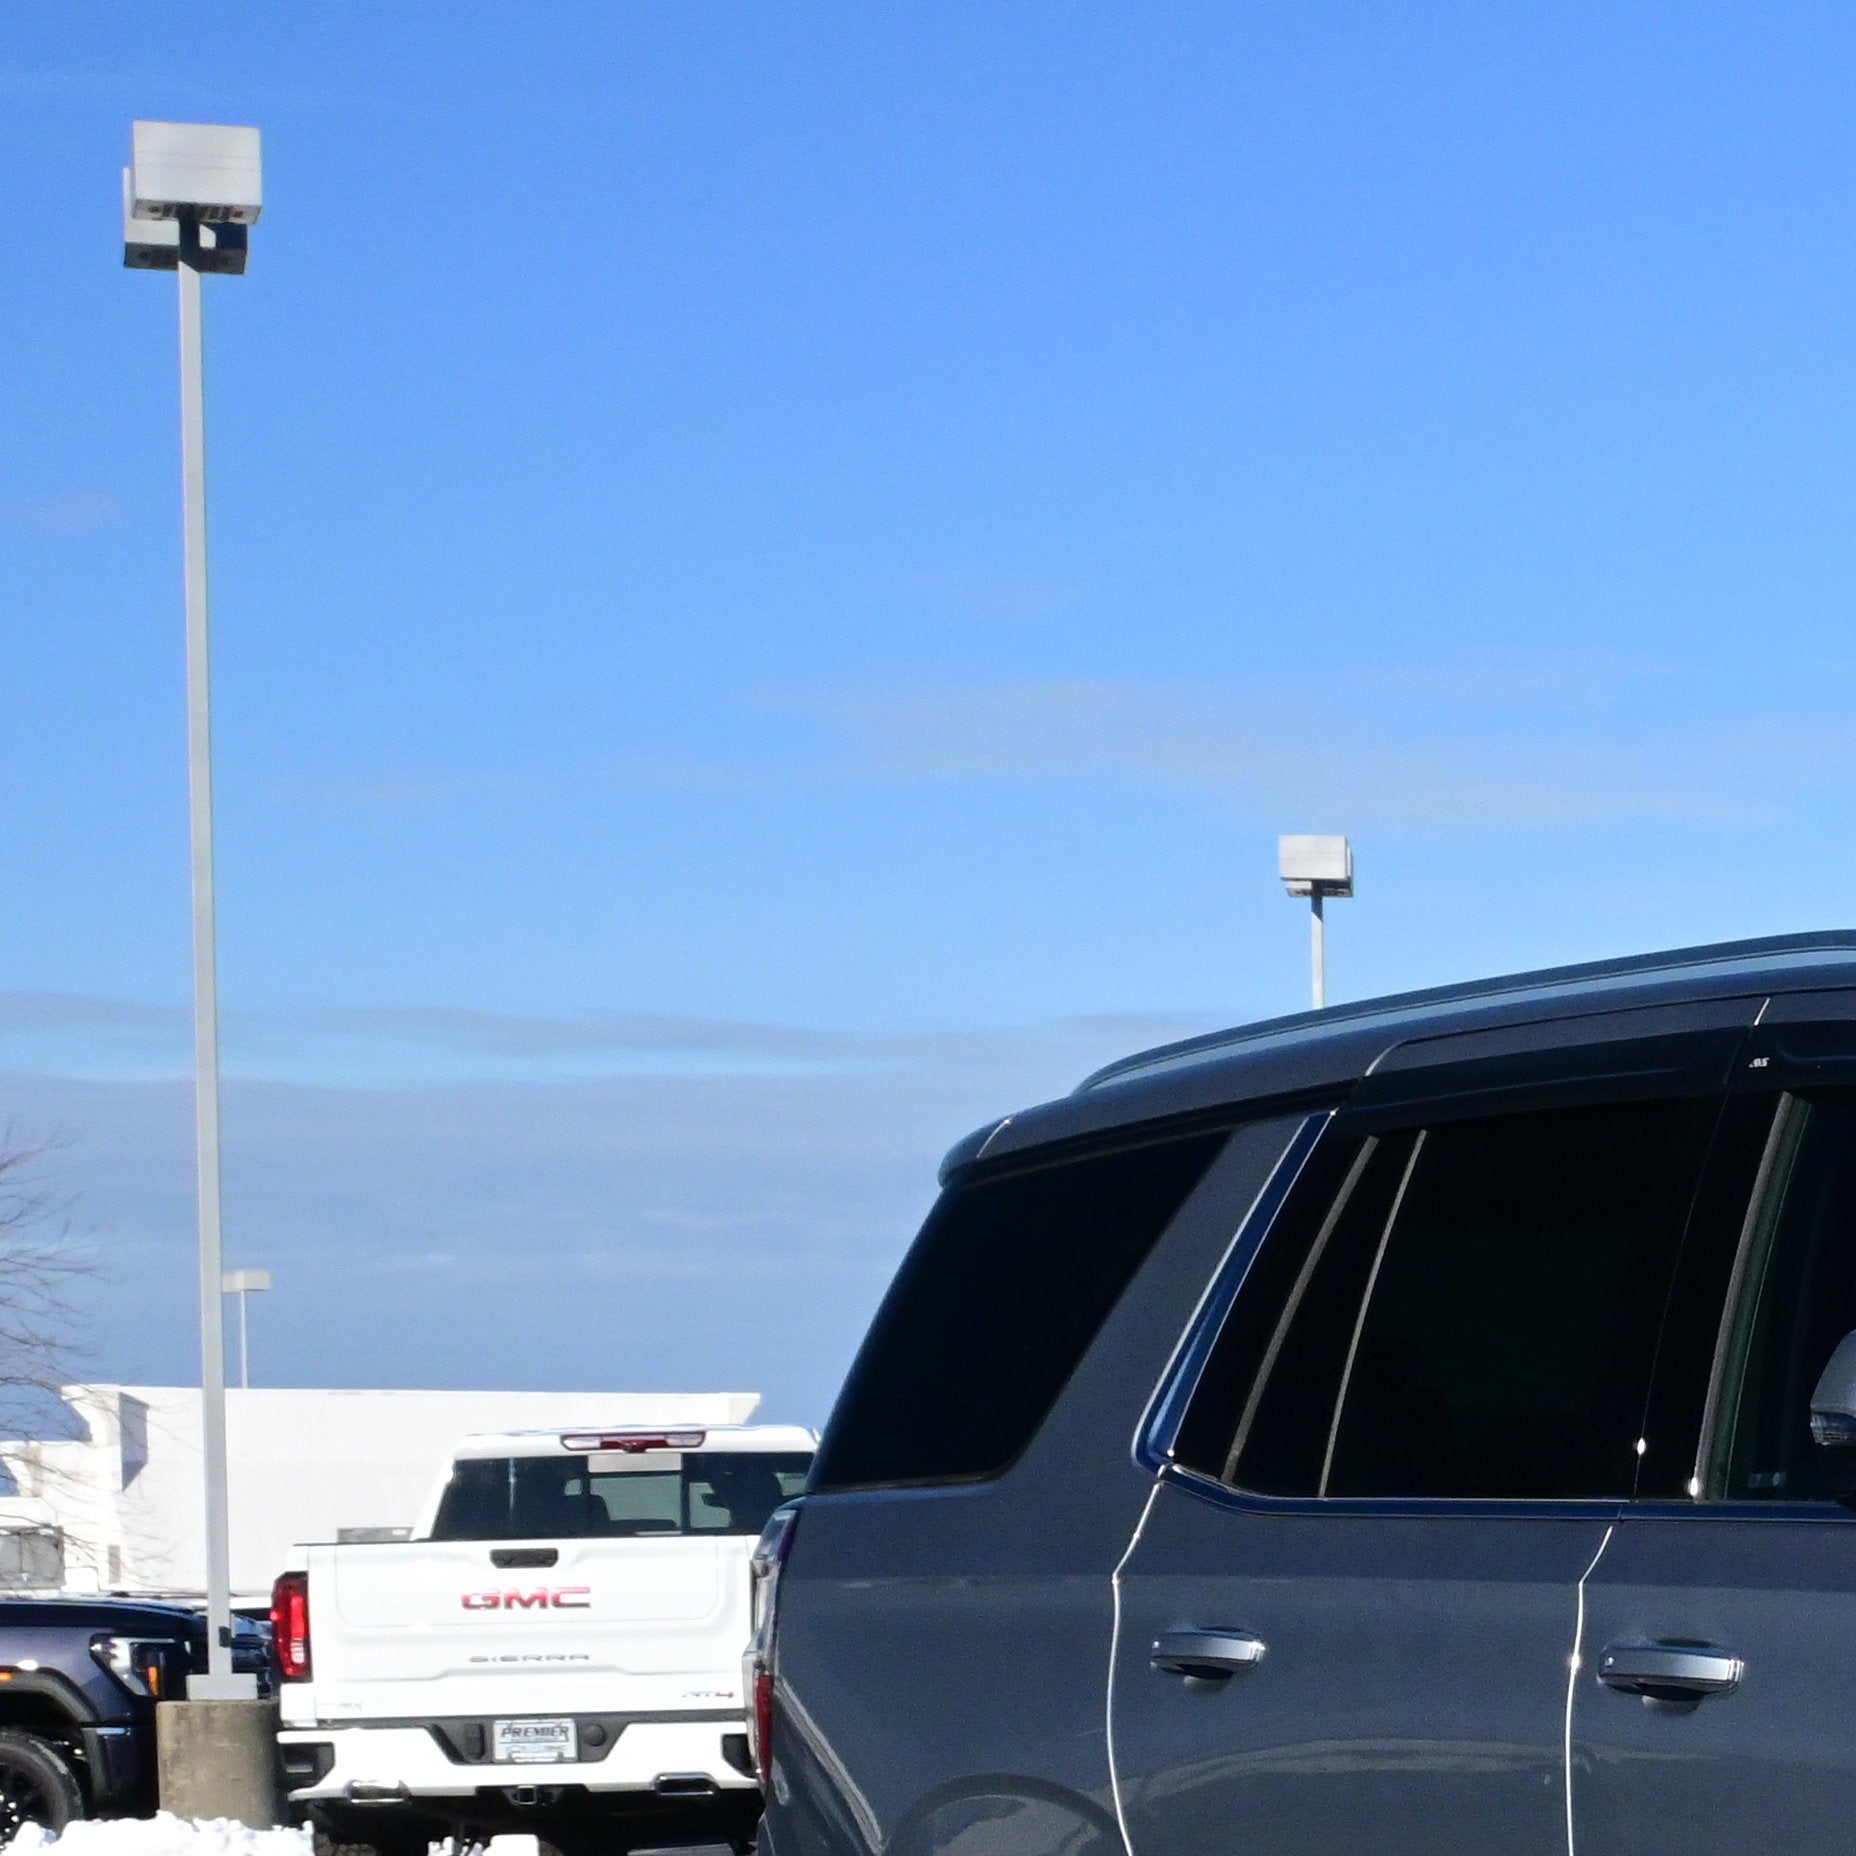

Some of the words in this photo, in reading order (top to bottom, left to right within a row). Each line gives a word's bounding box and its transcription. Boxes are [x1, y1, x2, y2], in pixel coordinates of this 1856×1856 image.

[462, 1587, 590, 1609] GMC
[469, 1653, 589, 1663] SIERRA
[501, 1725, 569, 1738] PREMIER
